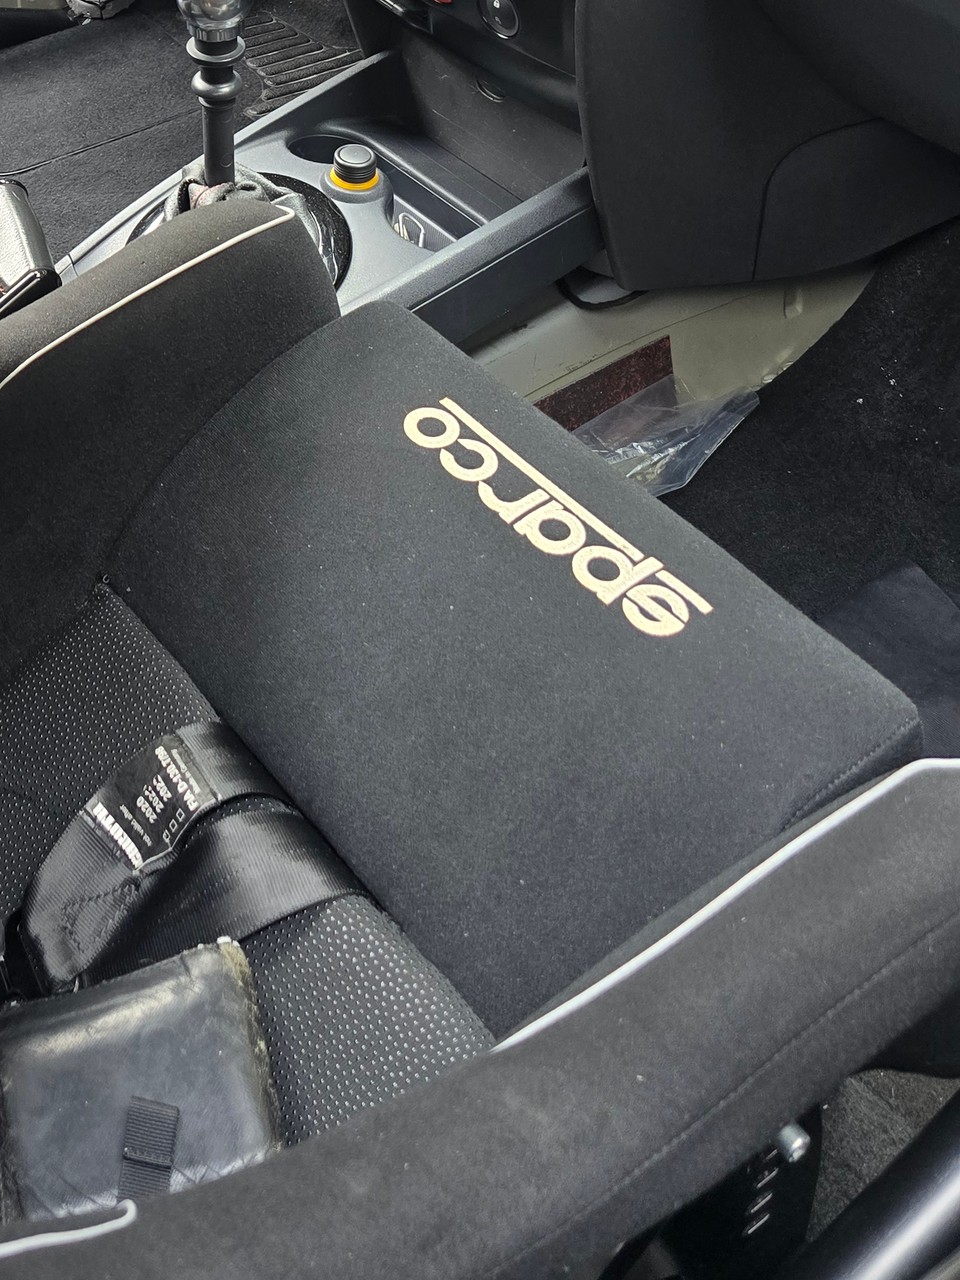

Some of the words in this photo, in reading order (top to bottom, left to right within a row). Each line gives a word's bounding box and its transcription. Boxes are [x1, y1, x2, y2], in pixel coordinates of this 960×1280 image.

[404, 398, 714, 637] sparco
[136, 795, 158, 824] 2020
[183, 789, 200, 812] FIA
[130, 818, 144, 836] valid
